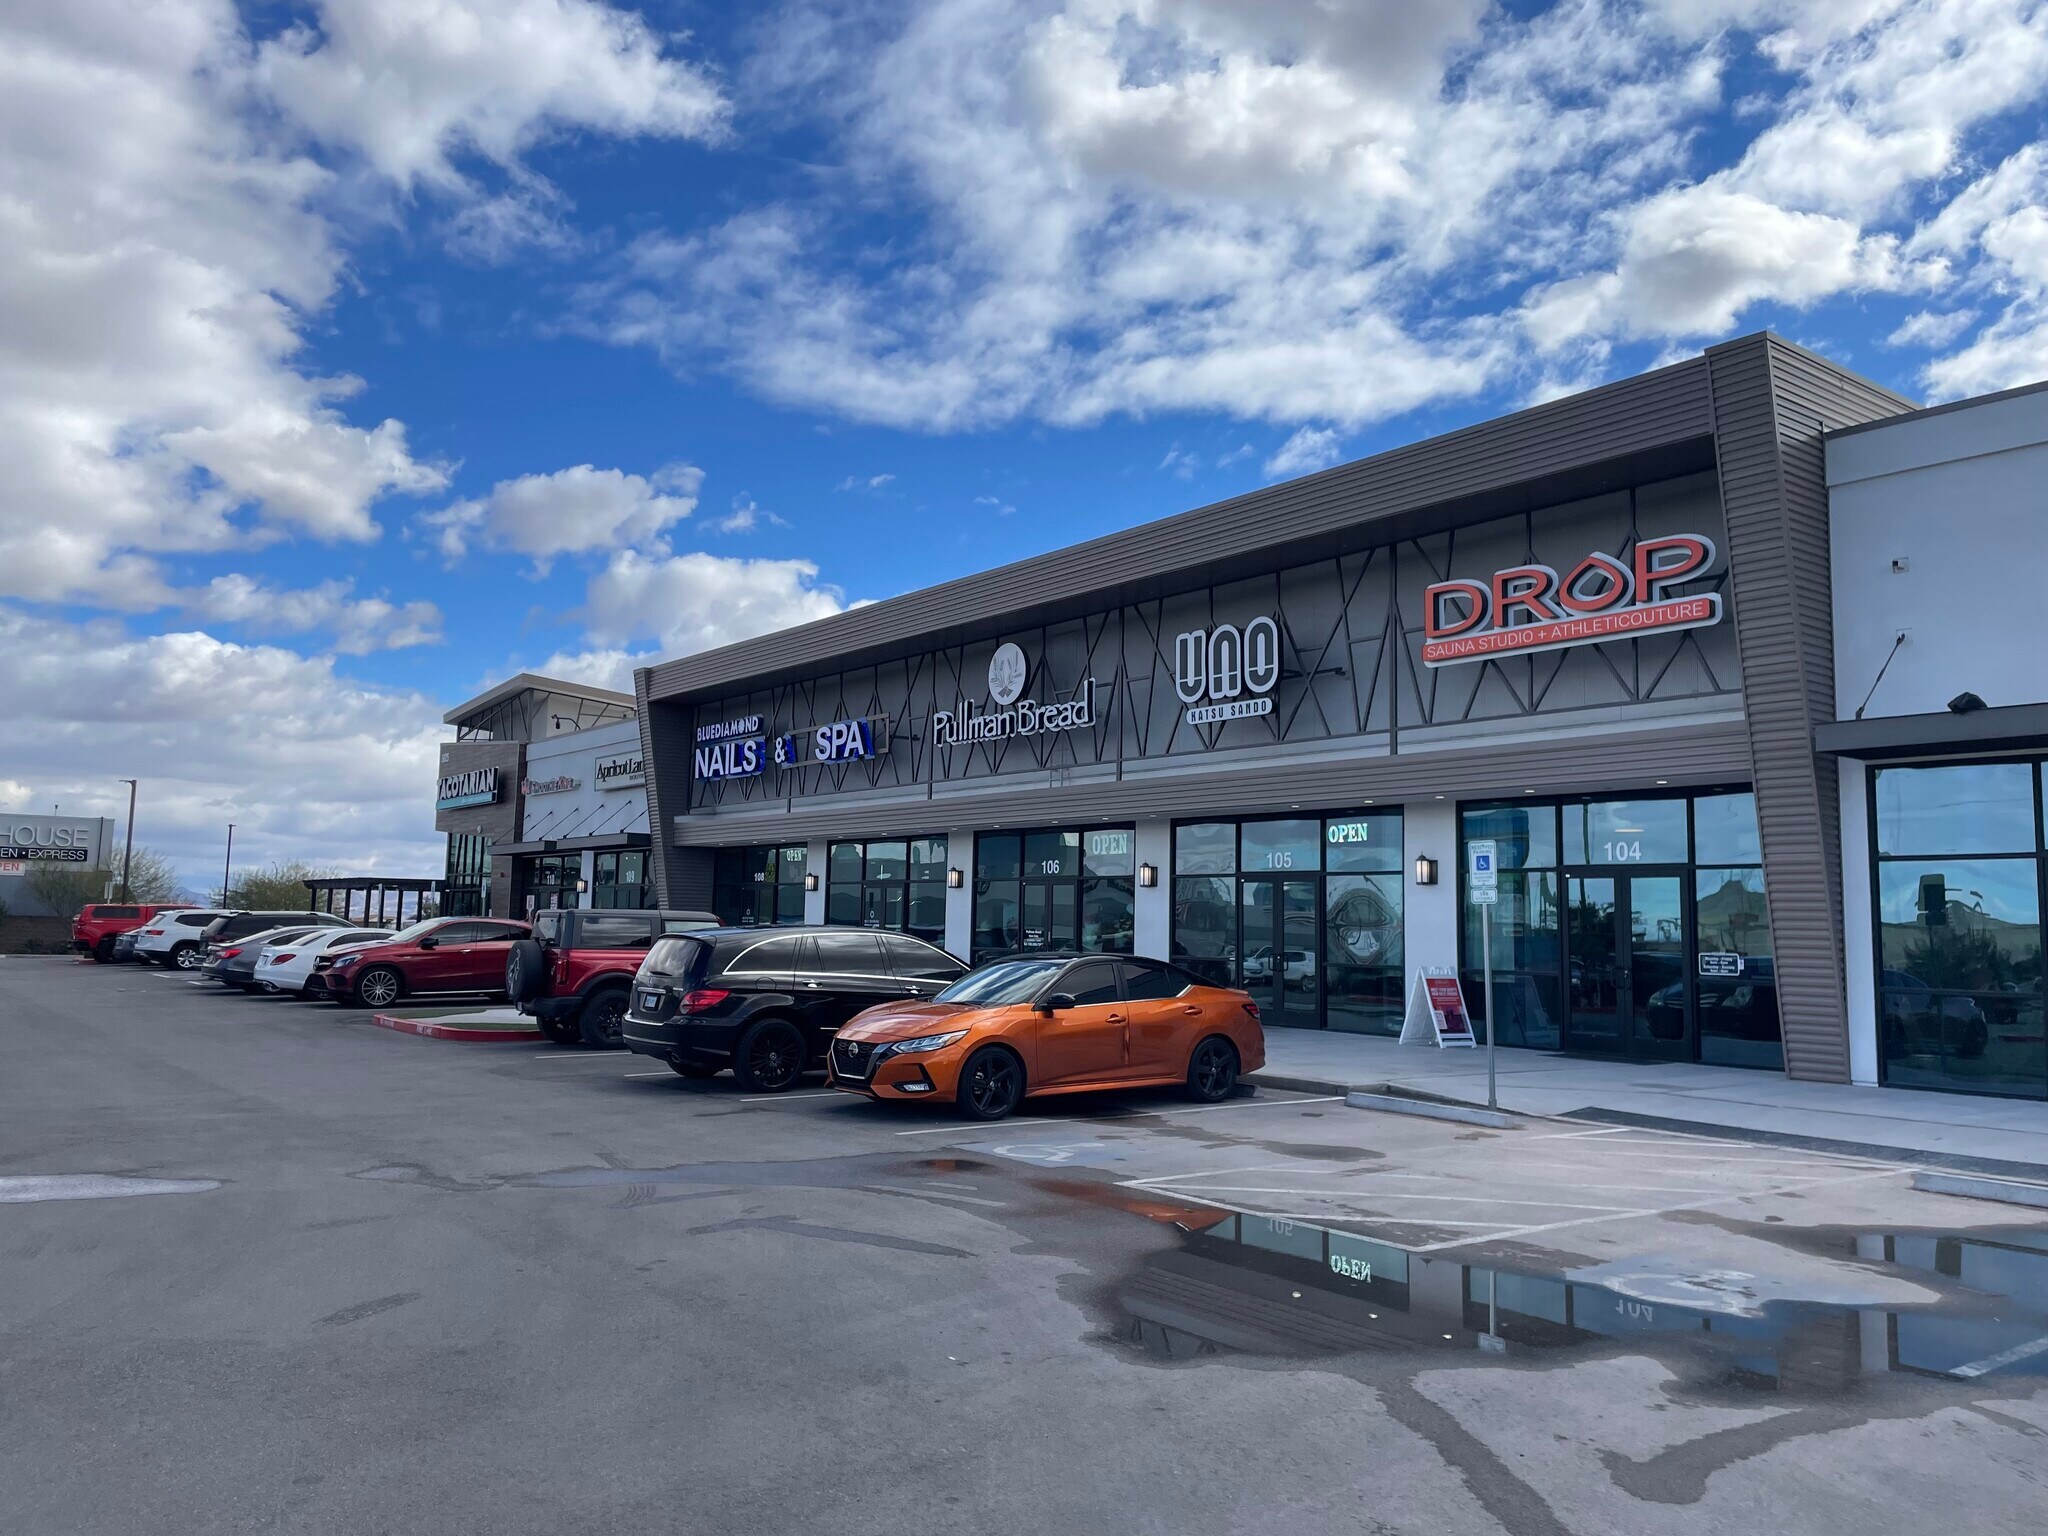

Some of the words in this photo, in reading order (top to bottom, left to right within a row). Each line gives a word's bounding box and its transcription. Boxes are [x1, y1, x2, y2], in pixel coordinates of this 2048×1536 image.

[1424, 536, 1708, 638] DROP
[1427, 639, 1476, 659] SAUNA
[1478, 629, 1534, 650] STUDIO
[1551, 602, 1704, 639] ATHLETICOUTURE
[1175, 615, 1279, 703] UNO
[933, 700, 1012, 746] Pullman
[1017, 678, 1092, 733] Bread
[1190, 706, 1224, 722] KATSU
[1230, 700, 1267, 716] SANDO
[694, 740, 757, 779] NAILS
[774, 737, 786, 764] &
[814, 721, 865, 760] SPA
[596, 759, 629, 782] Apricot
[436, 767, 495, 801] TACOTARIAN
[0, 825, 89, 848] HOUSE
[1327, 823, 1368, 843] OPEN
[27, 848, 85, 861] EXPRESS
[786, 849, 802, 861] OPEN
[1092, 834, 1128, 855] OPEN
[1603, 841, 1642, 861] 104
[1041, 860, 1060, 874] 106
[1266, 852, 1292, 869] 105
